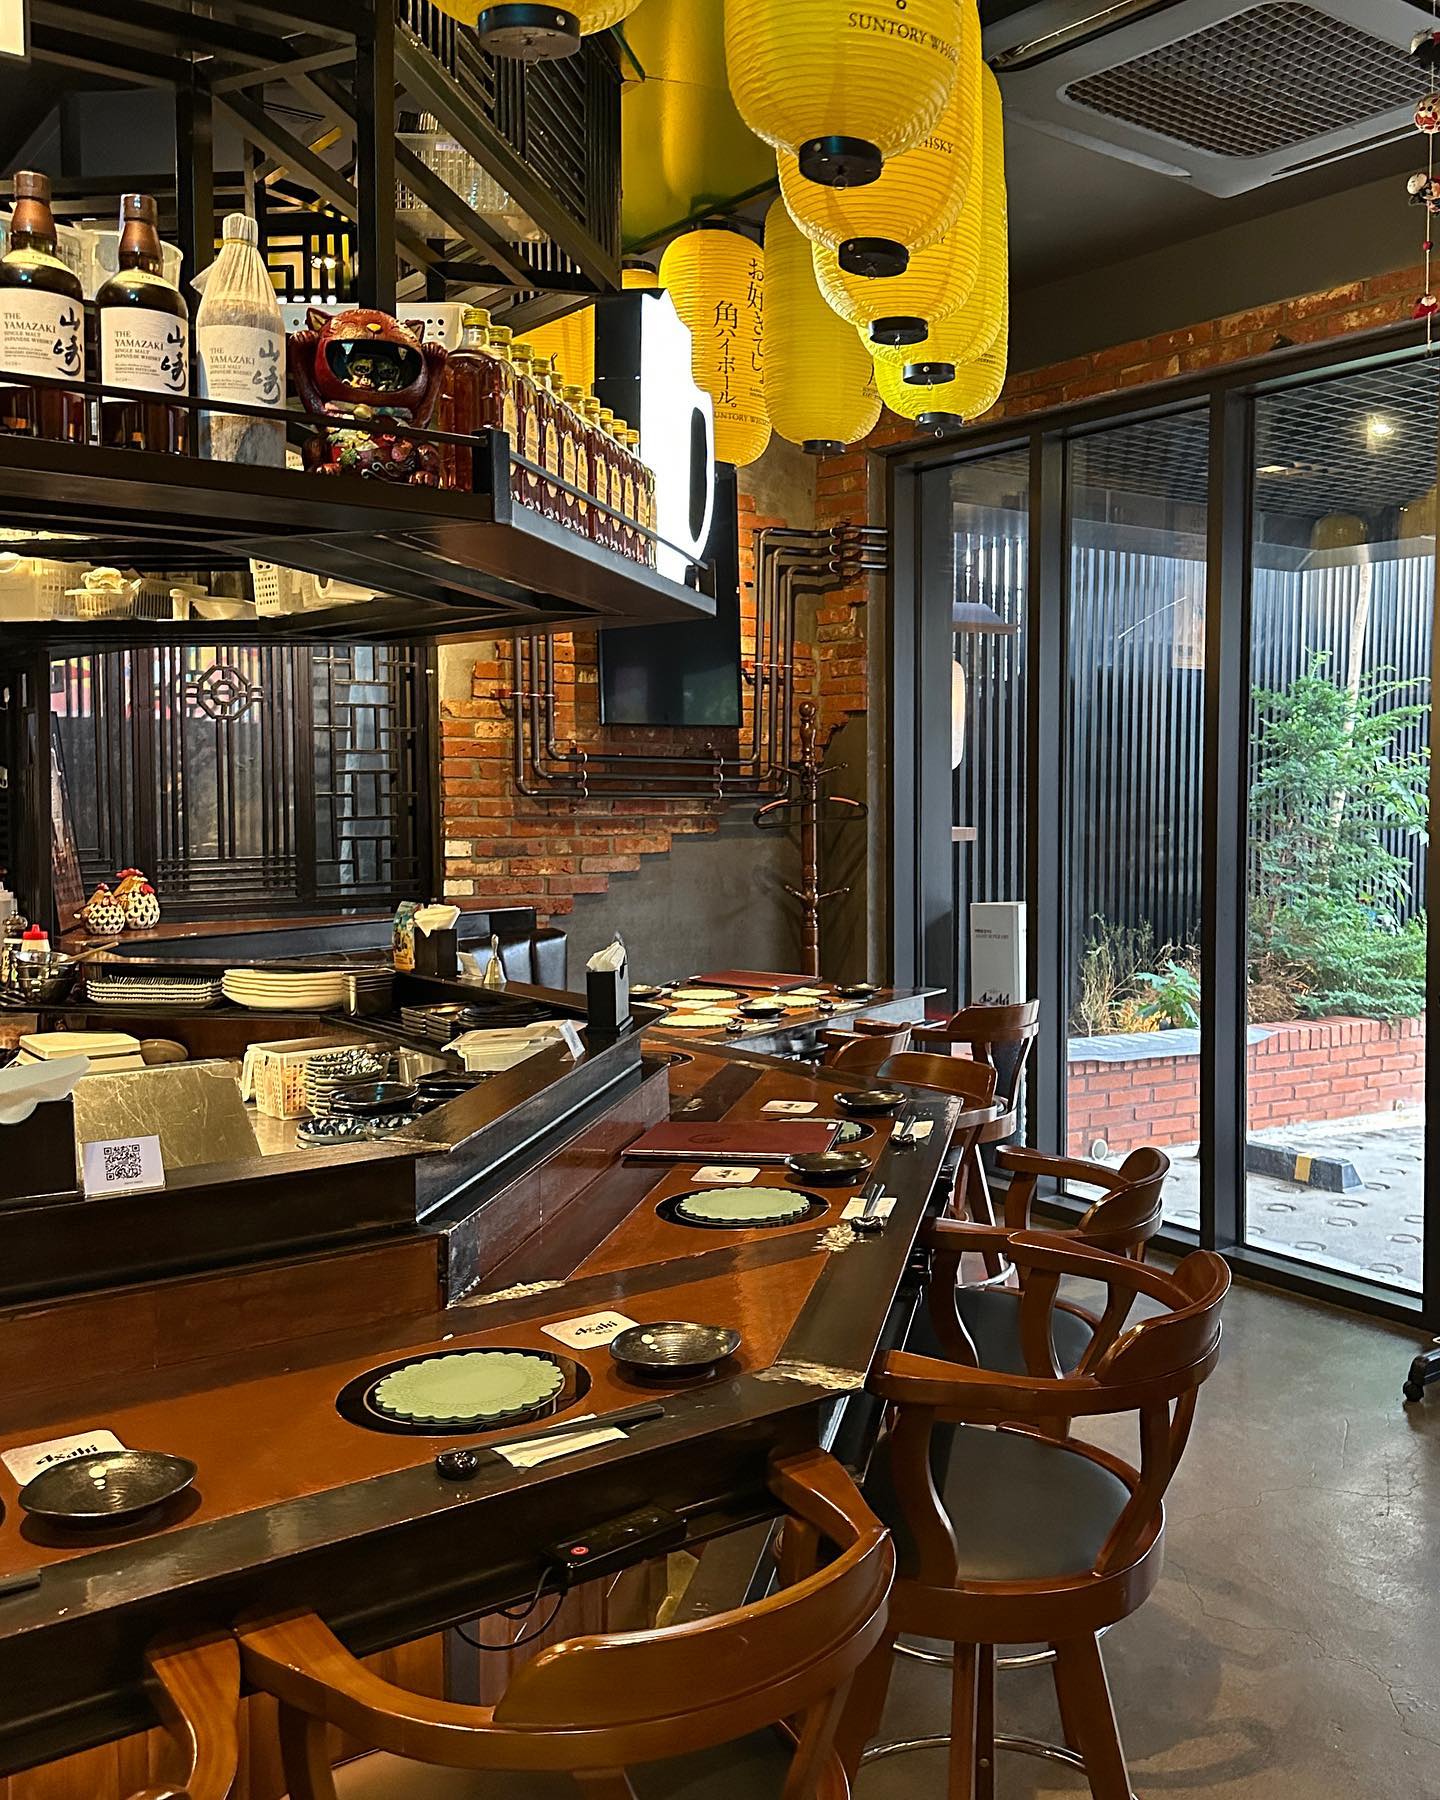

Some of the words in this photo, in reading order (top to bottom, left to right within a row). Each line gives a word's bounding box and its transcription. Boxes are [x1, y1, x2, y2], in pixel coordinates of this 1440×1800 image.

[848, 11, 928, 45] SUNTORY
[4, 312, 21, 320] THE
[4, 321, 56, 334] YAMAZAKI
[115, 330, 131, 338] THE
[115, 339, 164, 351] YAMAZAKI
[210, 355, 255, 366] YAMAZAKI
[713, 300, 738, 408] 角ハイボール。
[714, 411, 749, 424] UNTORY
[574, 1320, 618, 1336] Asahi
